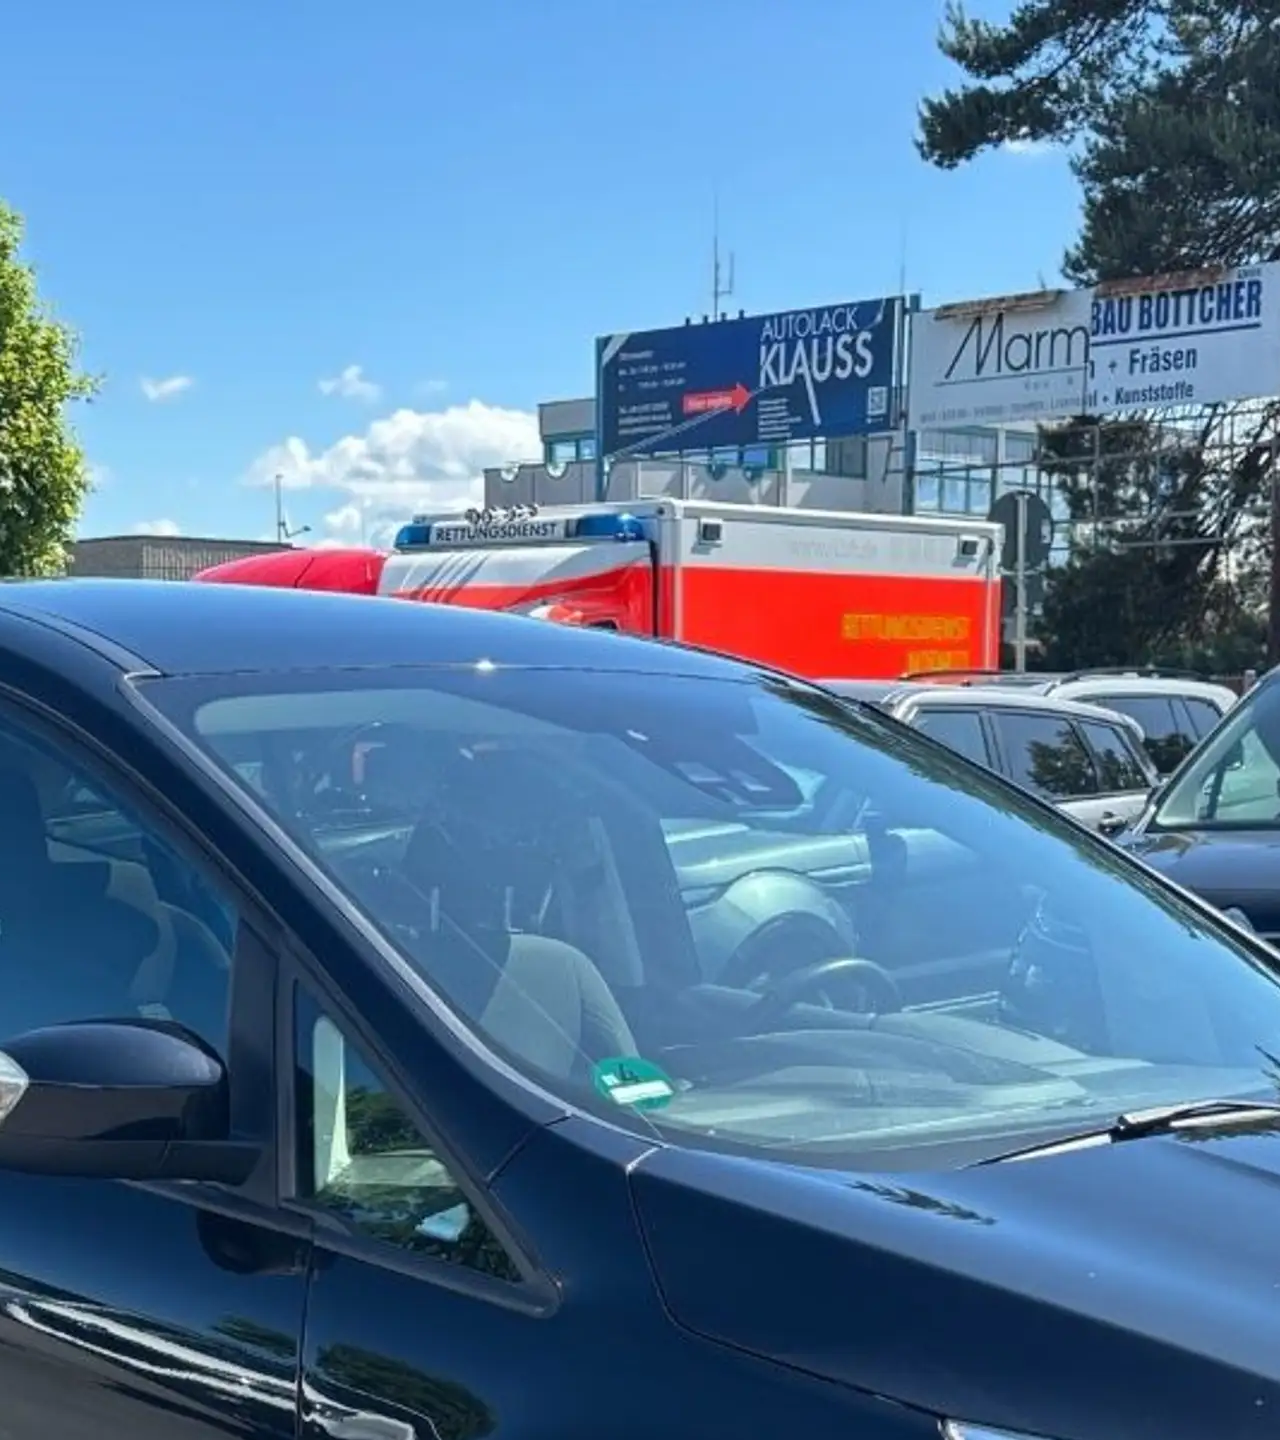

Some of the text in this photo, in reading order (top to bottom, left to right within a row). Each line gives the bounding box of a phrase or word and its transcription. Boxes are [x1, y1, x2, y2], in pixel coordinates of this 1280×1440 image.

[760, 307, 858, 342] AUTOLACK
[944, 312, 1090, 380] Marm
[1129, 346, 1197, 376] Fräsen
[760, 331, 874, 426] KLAUSS
[1115, 381, 1194, 405] Kunststoffe
[435, 522, 557, 541] RETTUNGSDIENST
